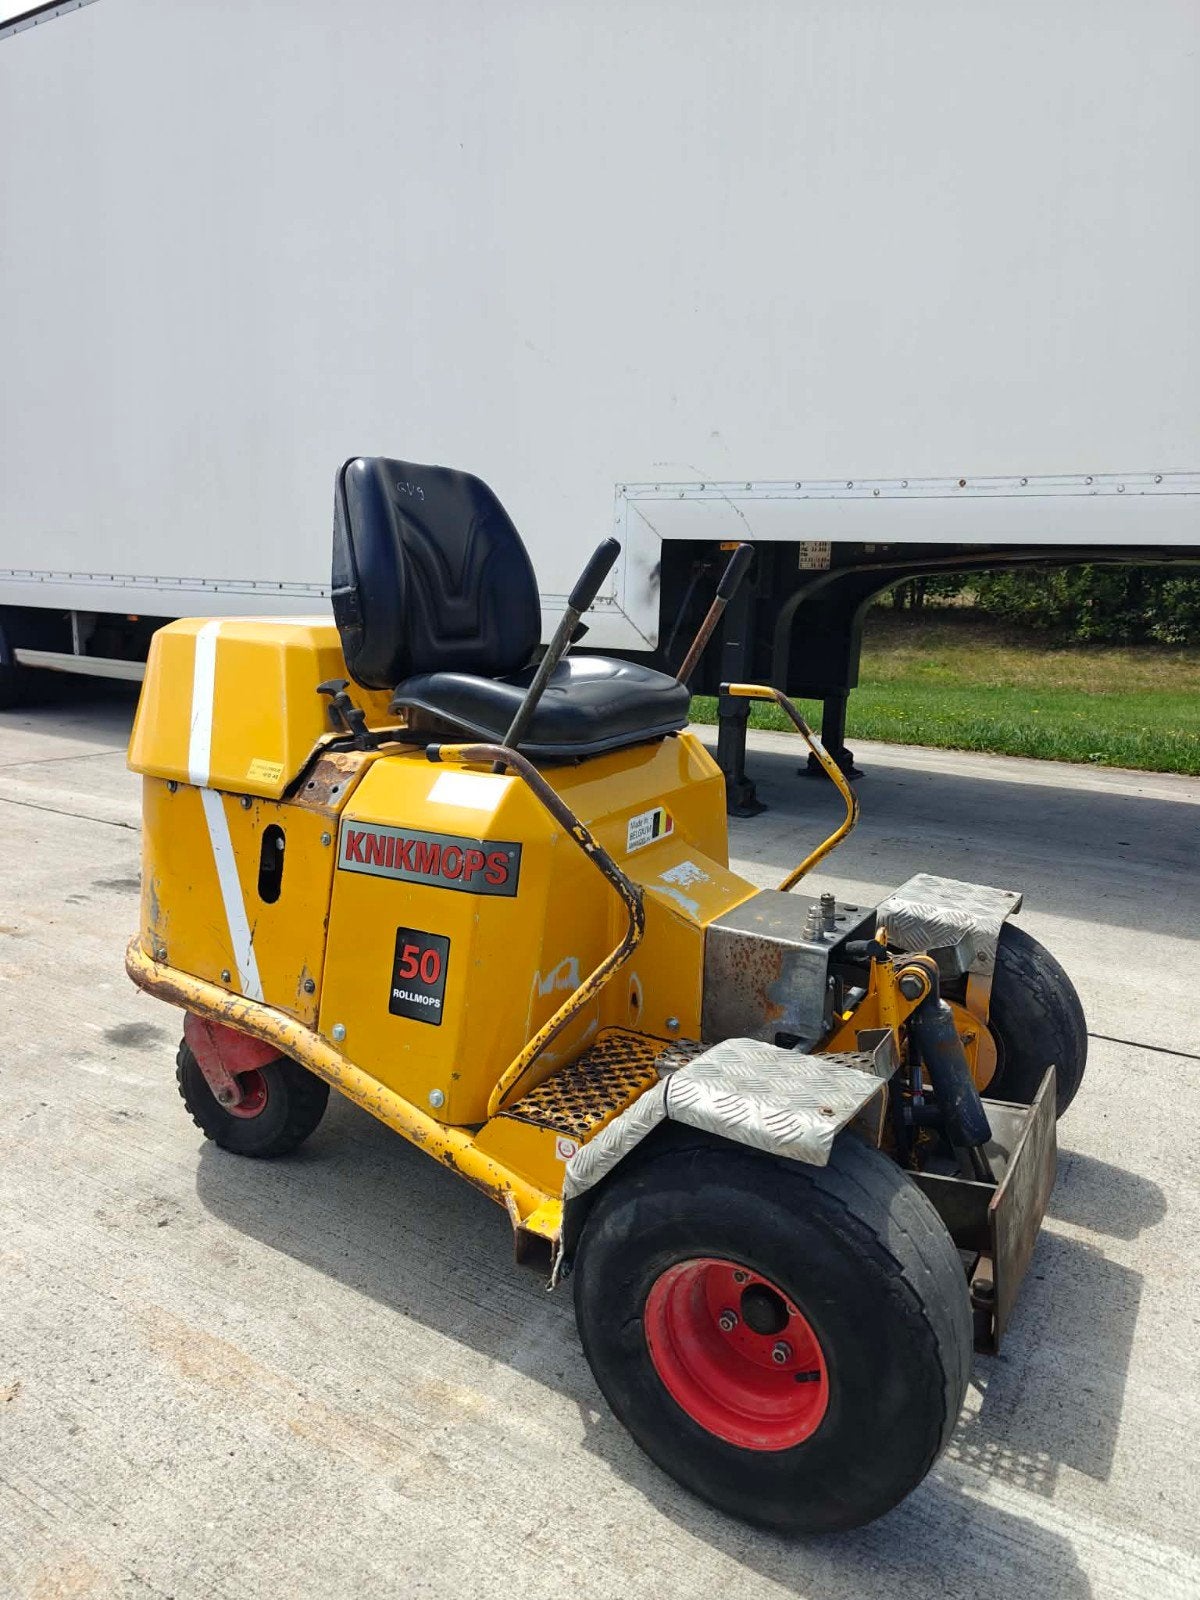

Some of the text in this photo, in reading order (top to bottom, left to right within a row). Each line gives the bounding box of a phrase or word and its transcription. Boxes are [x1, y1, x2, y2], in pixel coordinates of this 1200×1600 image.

[629, 825, 652, 840] BELGIUM
[345, 829, 509, 885] KNIKMOPS
[399, 944, 441, 984] 50
[393, 988, 441, 1008] ROLLMOPS
